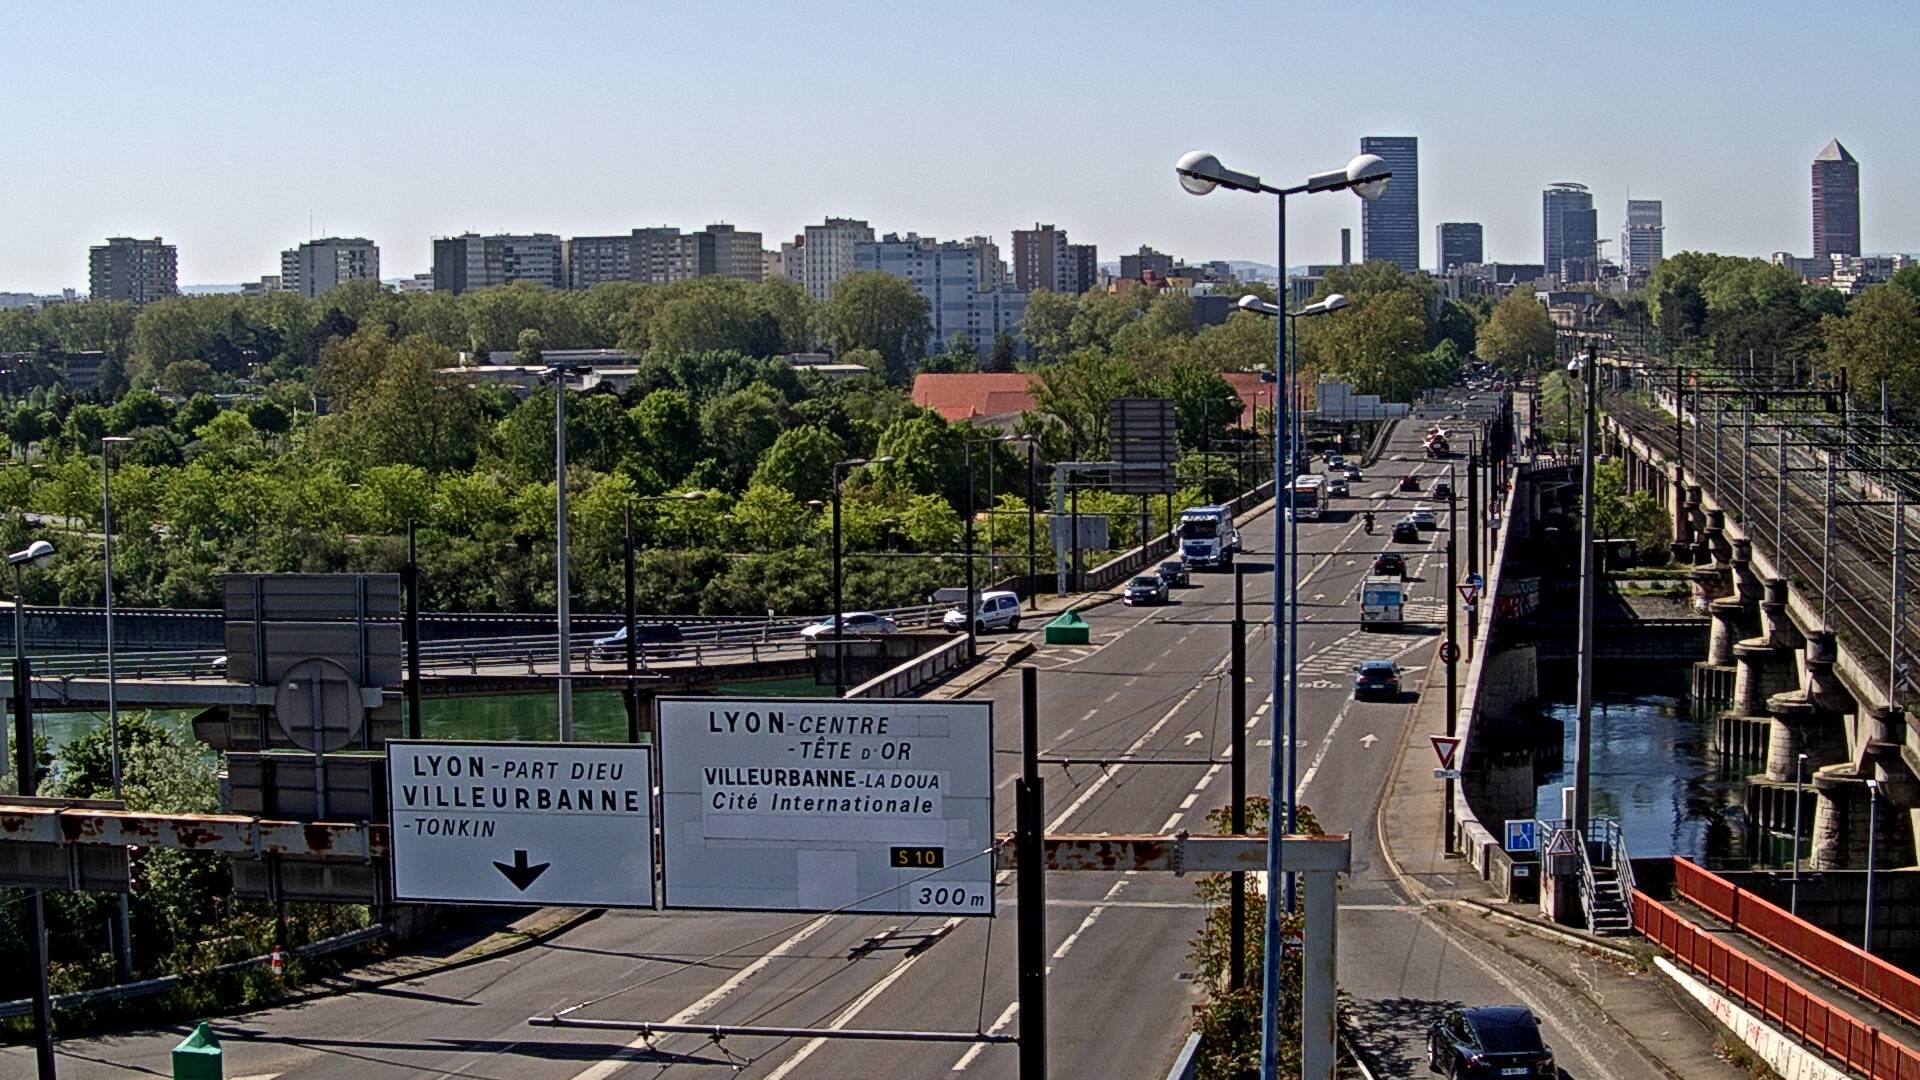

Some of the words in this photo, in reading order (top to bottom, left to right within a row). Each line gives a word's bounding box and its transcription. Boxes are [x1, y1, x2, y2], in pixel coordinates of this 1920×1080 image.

[571, 762, 624, 781] DIEU
[890, 775, 940, 789] DOUA
[402, 784, 639, 812] VILLEURBANNE
[712, 791, 759, 811] Cité
[771, 793, 933, 814] Internationale
[918, 887, 966, 906] 300
[970, 895, 985, 907] m
